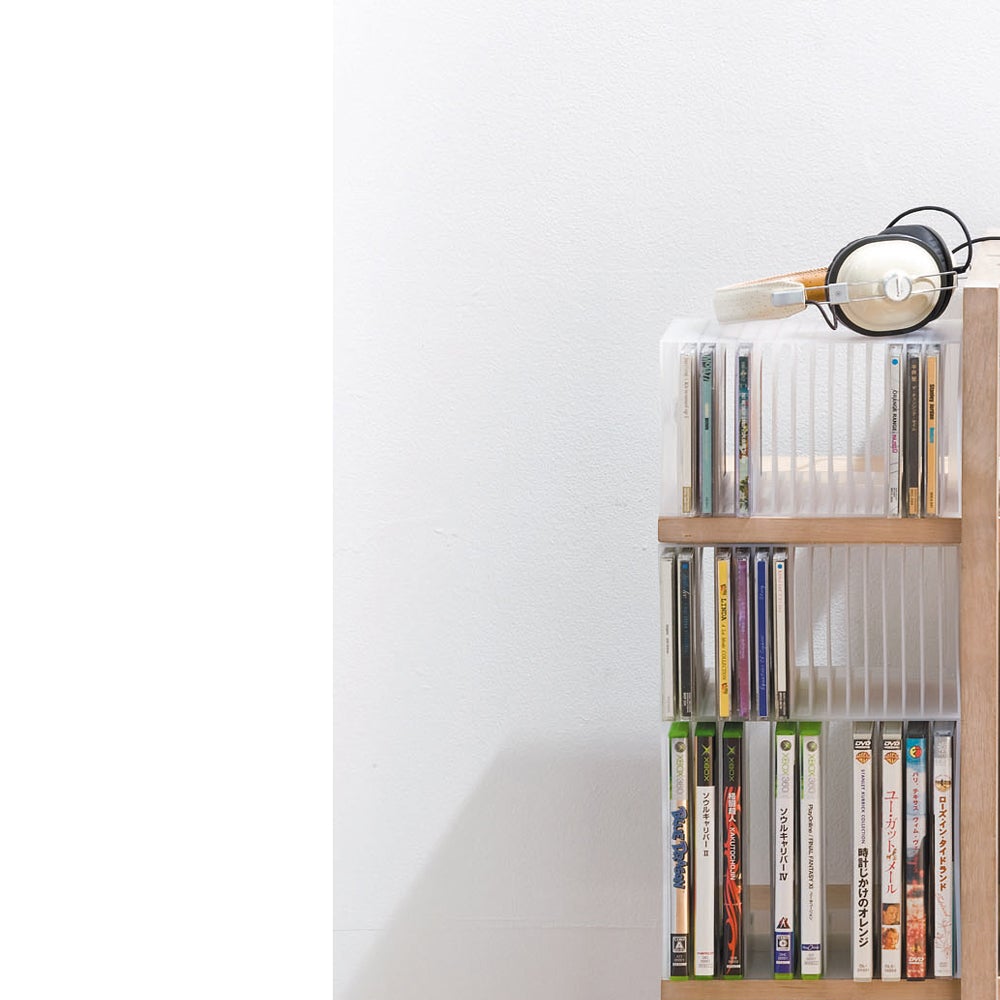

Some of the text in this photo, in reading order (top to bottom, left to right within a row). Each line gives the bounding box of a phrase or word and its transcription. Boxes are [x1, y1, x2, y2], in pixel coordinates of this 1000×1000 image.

[671, 806, 688, 890] BLUE DRAGON
[939, 796, 948, 892] ローズ・イン・タイドランド
[858, 848, 869, 948] 時計じかけのオレンジ
